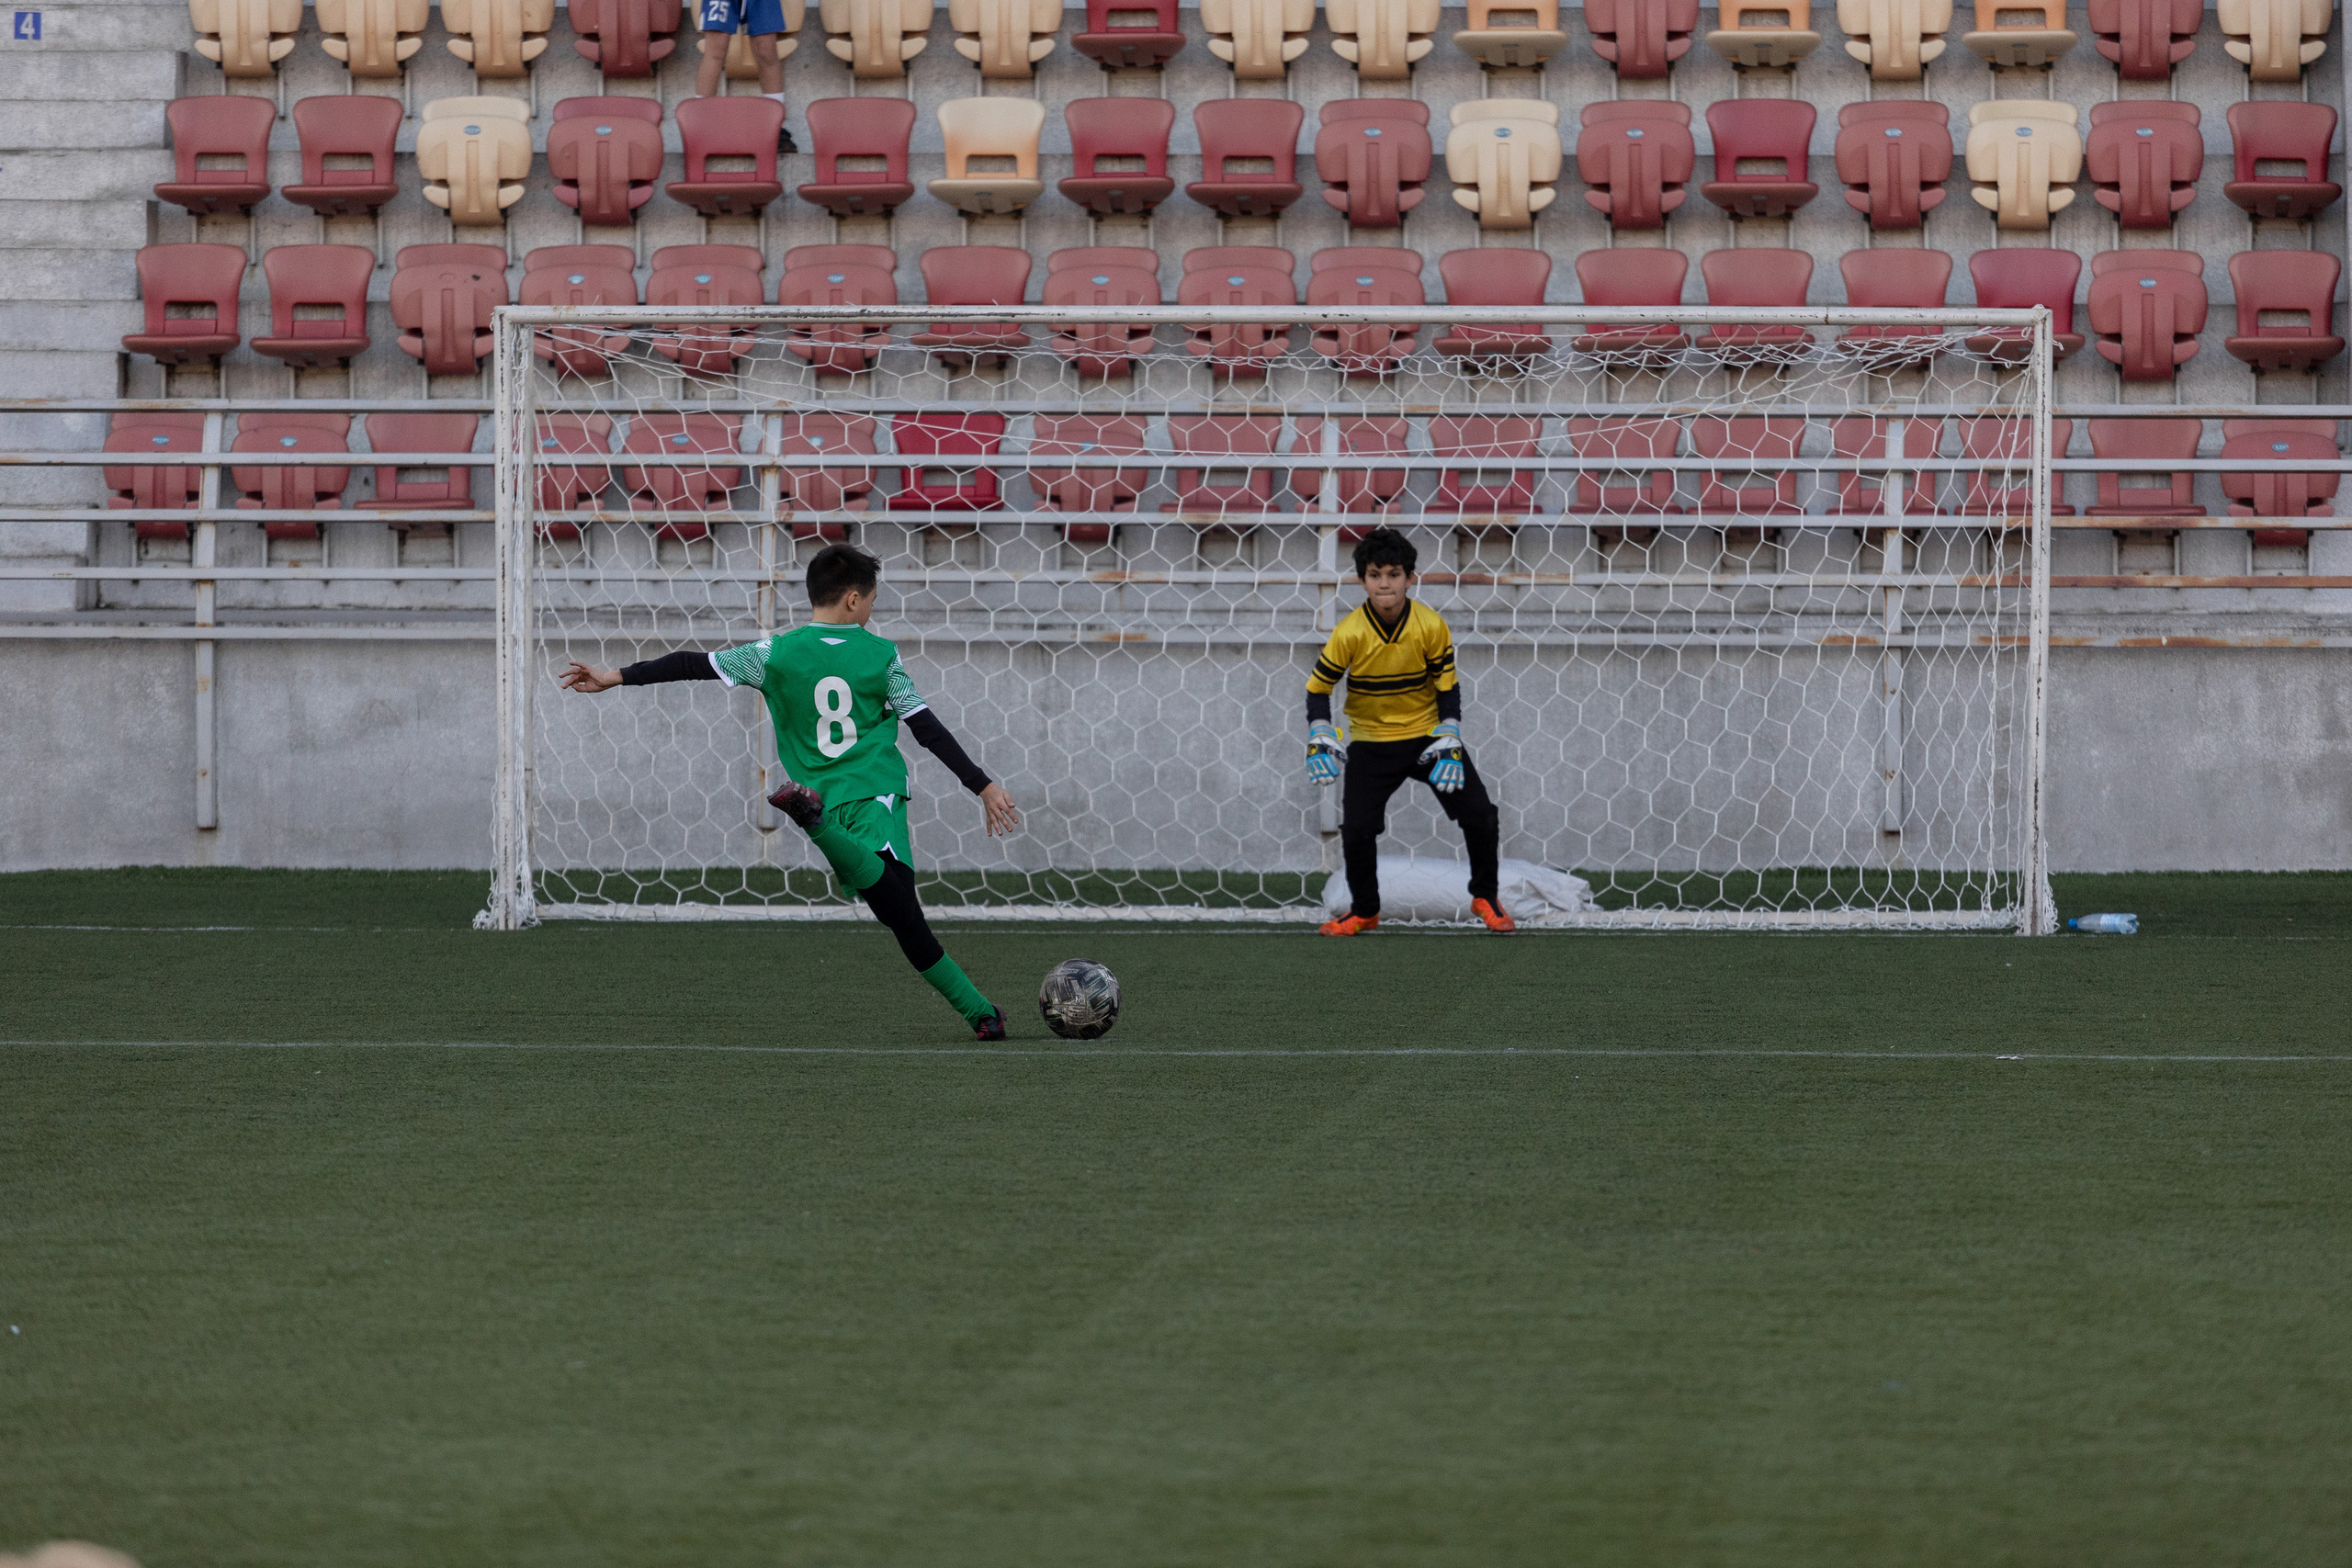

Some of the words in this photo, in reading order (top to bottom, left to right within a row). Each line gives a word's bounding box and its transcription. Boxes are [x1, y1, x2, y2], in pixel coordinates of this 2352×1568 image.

[707, 0, 730, 23] 25
[19, 12, 36, 39] 4
[814, 675, 858, 759] 8
